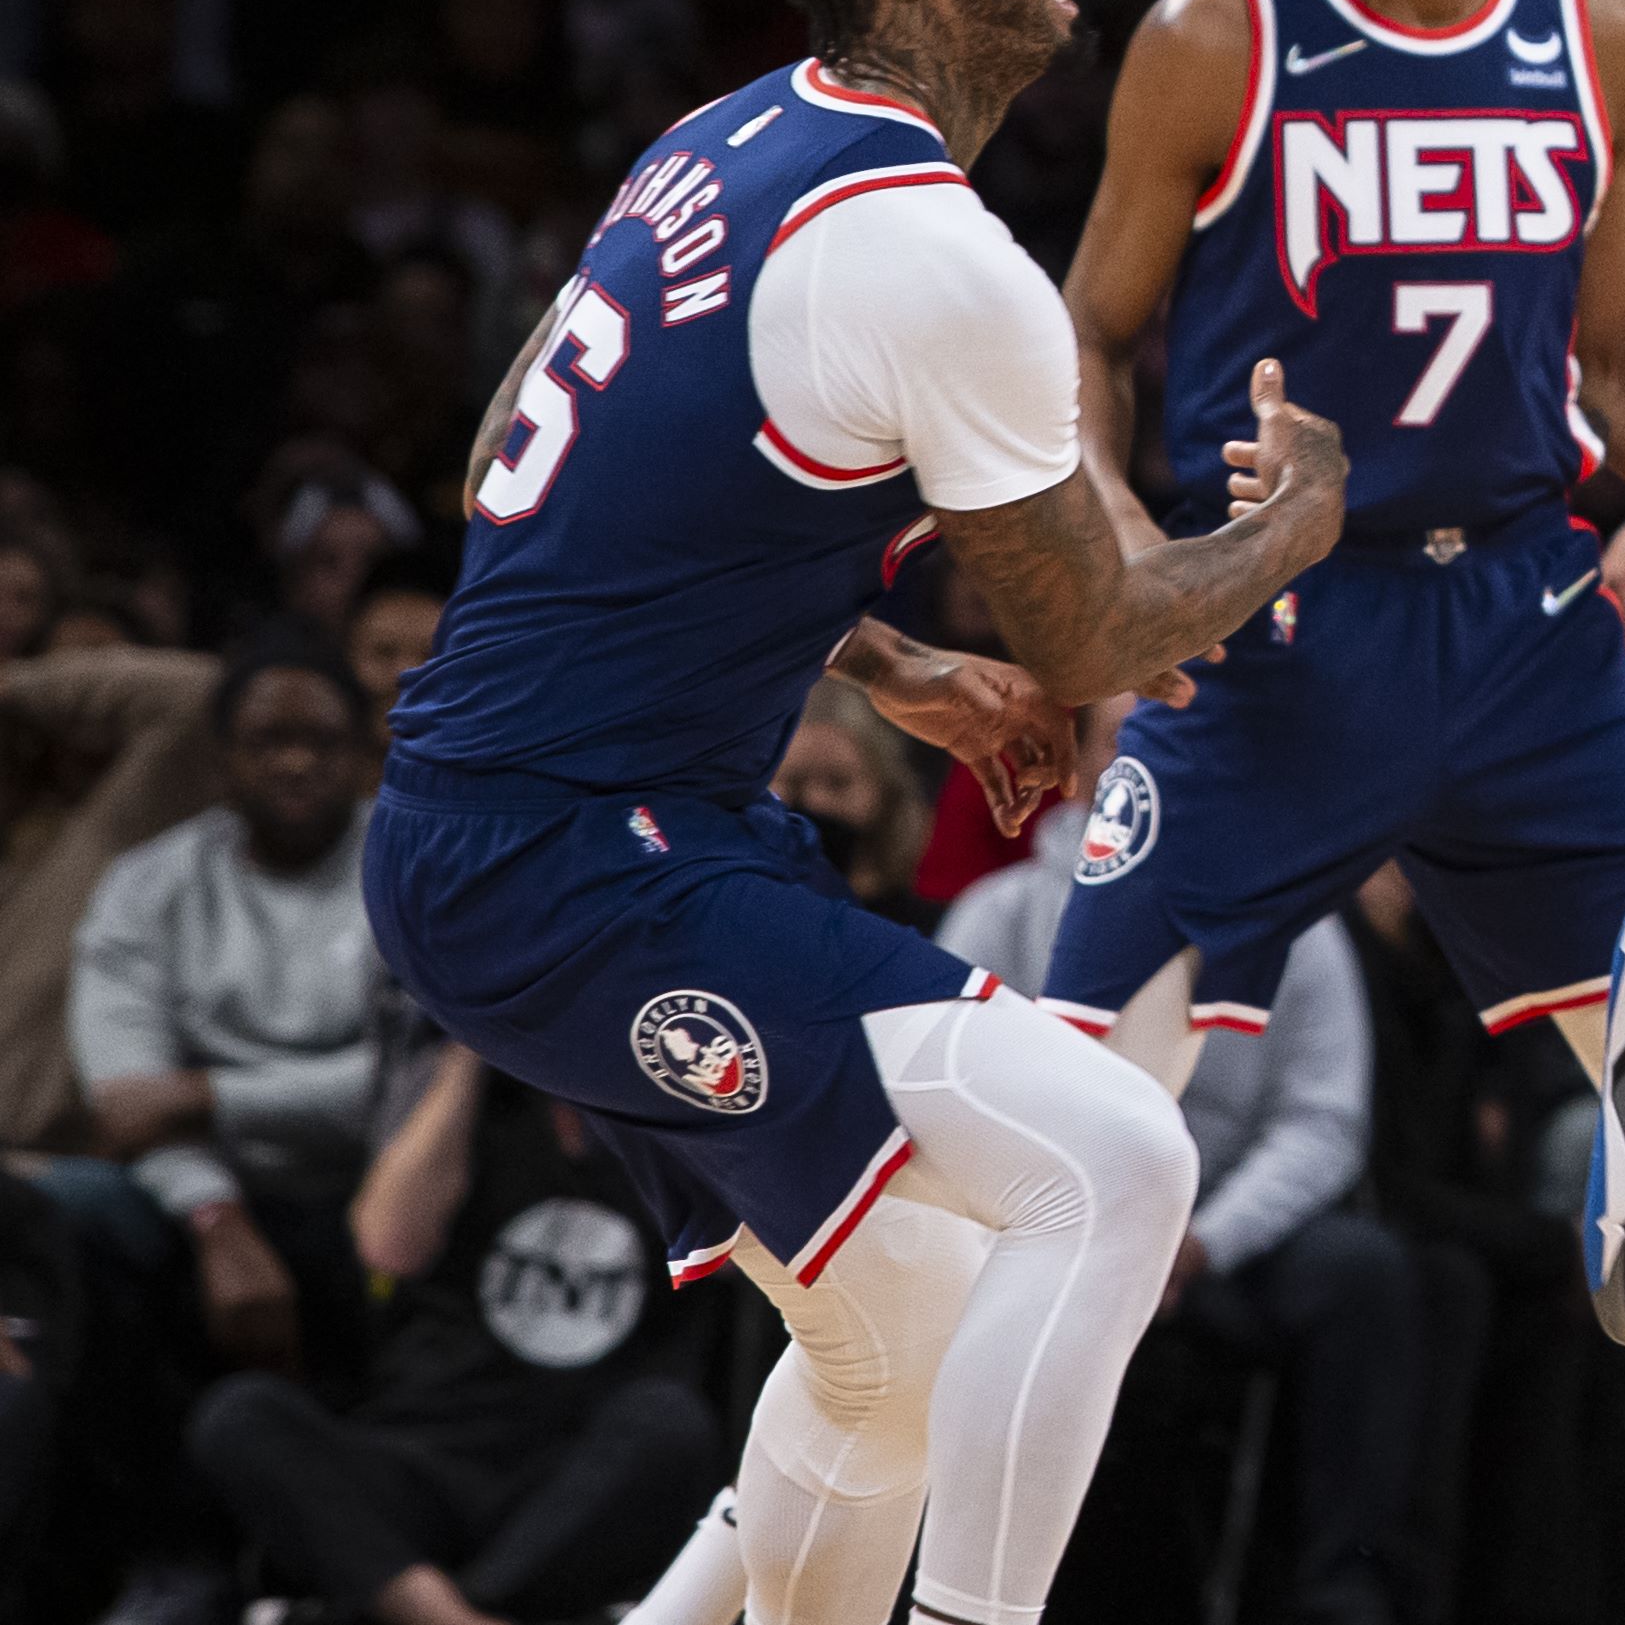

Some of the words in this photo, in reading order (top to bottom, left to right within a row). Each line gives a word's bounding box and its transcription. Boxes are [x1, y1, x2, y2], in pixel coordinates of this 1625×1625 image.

[588, 150, 733, 328] OHNSON
[1273, 108, 1588, 320] NETS
[1392, 280, 1494, 427] 7
